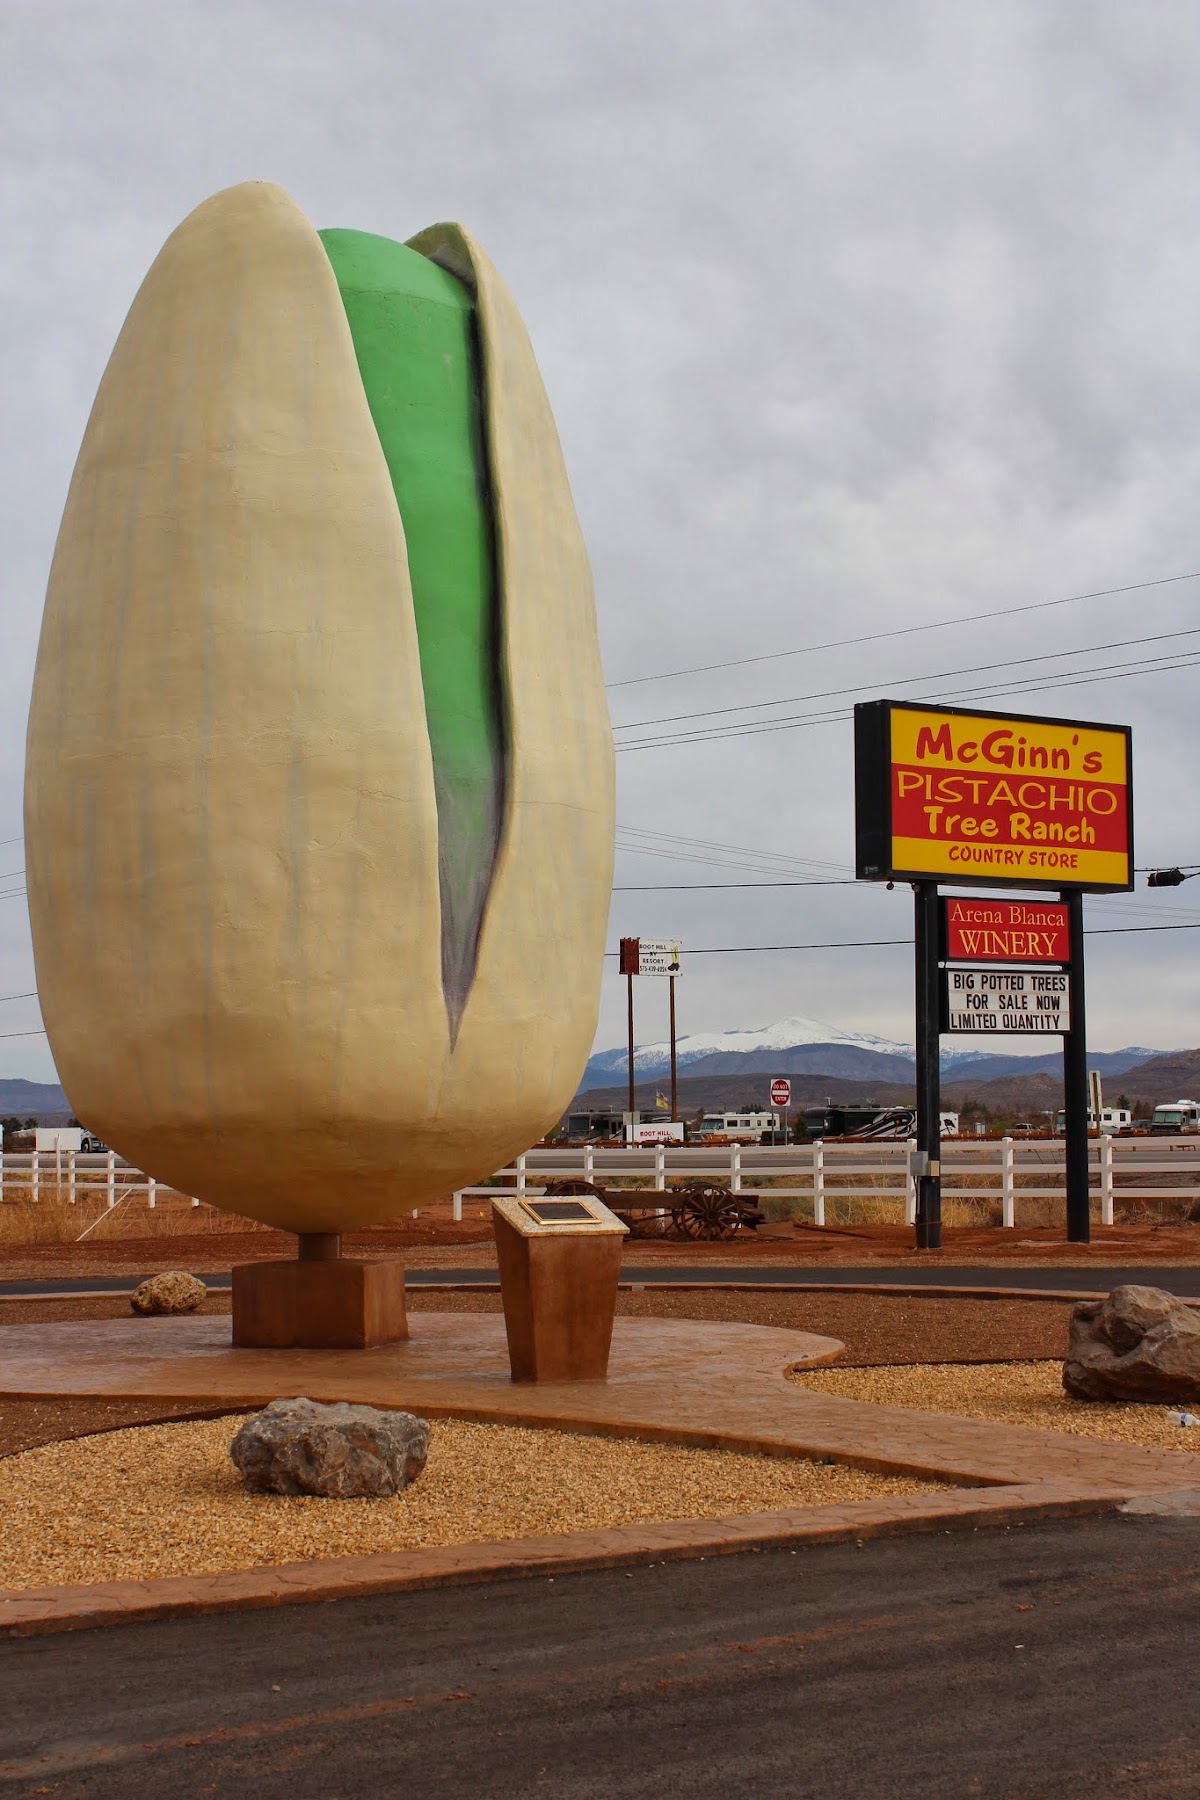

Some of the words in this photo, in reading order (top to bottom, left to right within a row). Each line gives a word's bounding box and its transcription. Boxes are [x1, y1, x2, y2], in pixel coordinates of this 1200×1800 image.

[916, 723, 1103, 773] McGinn's
[897, 771, 1118, 815] PISTACHIO
[923, 806, 999, 837] Tree
[1009, 812, 1096, 845] Ranch
[948, 846, 1024, 865] COUNTRY
[1028, 851, 1078, 868] STORE
[951, 903, 1003, 923] Arena
[1008, 906, 1065, 927] Blanca
[958, 929, 1058, 956] WINERY
[954, 974, 975, 989] BIG
[981, 975, 1024, 990] POTTED
[1031, 976, 1066, 991] TREES
[966, 994, 988, 1009] FOR
[999, 995, 1028, 1010] SALE
[1036, 996, 1060, 1010] NOW
[951, 1014, 997, 1028] LIMITED
[1003, 1014, 1060, 1029] QUANTITY
